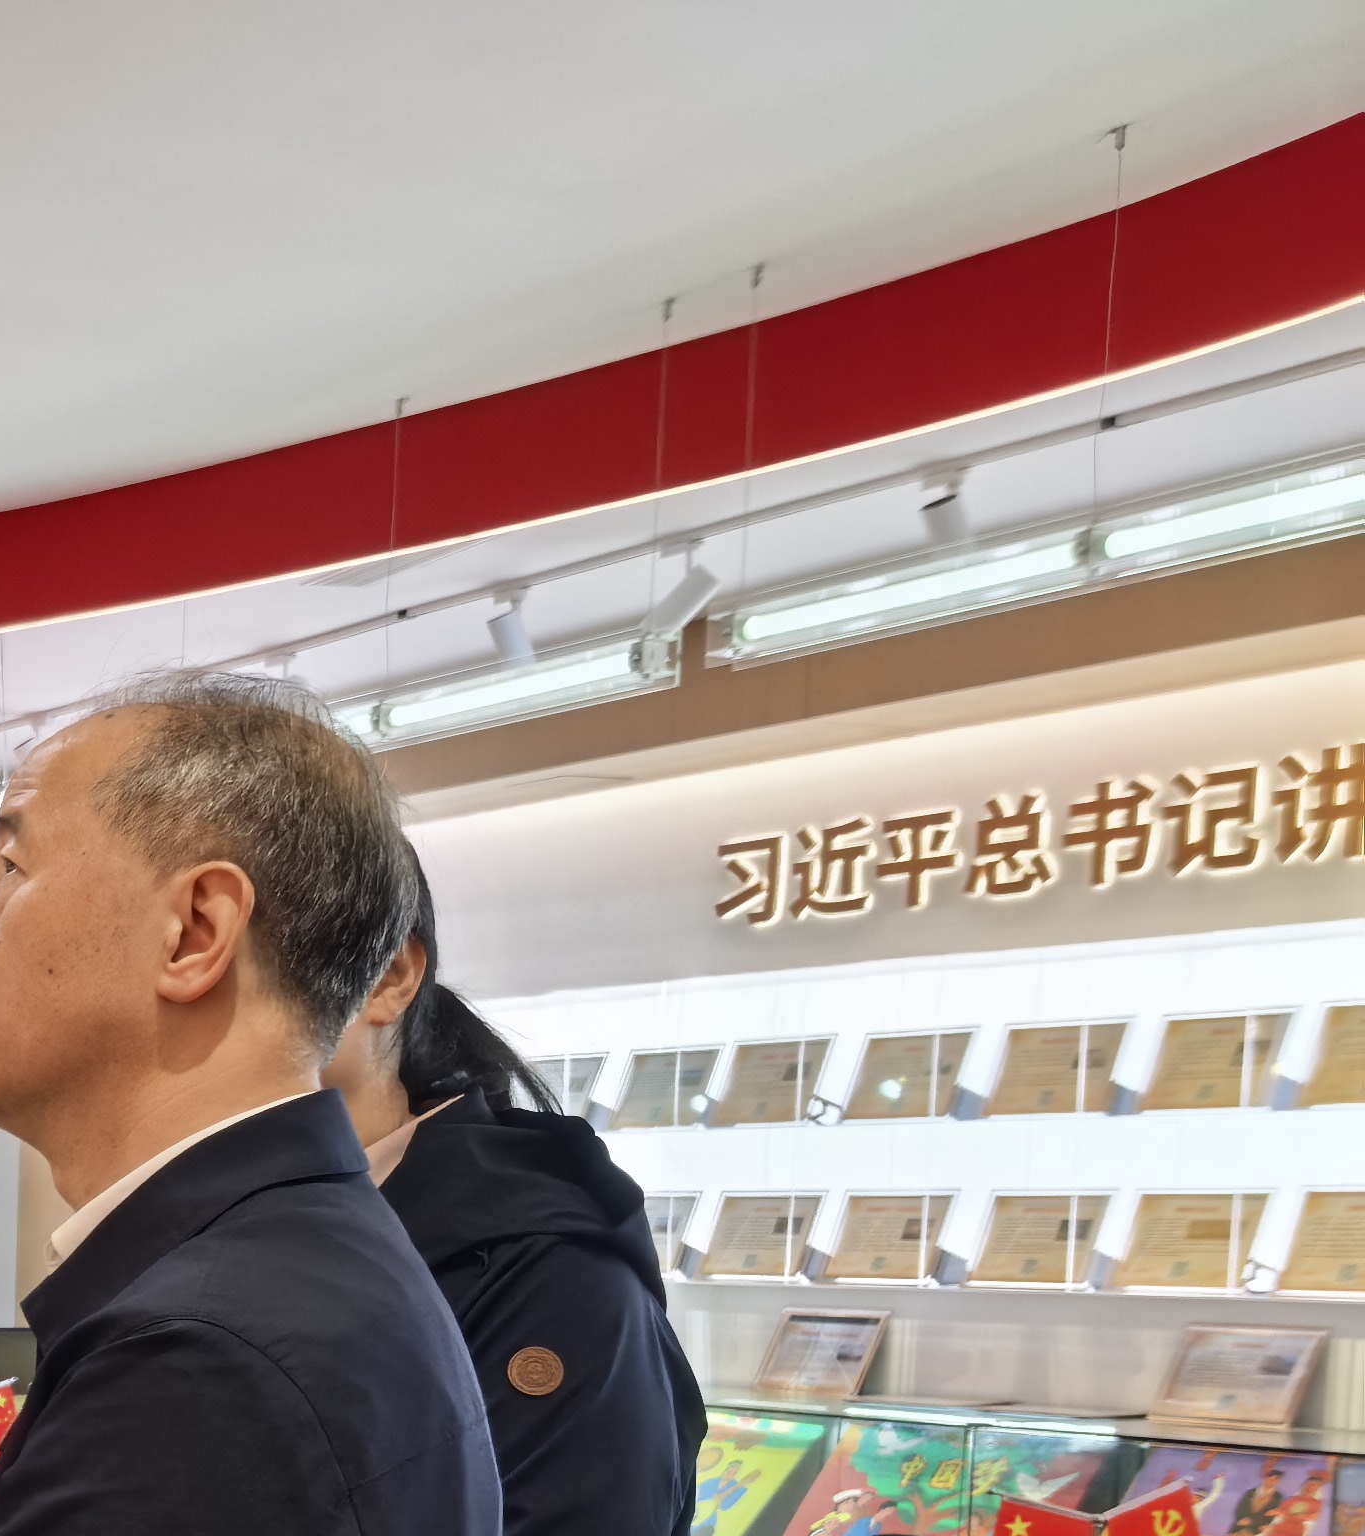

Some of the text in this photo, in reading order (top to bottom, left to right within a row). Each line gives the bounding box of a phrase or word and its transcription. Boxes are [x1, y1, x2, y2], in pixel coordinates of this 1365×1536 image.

[715, 742, 1365, 924] 习近平总书记讲
